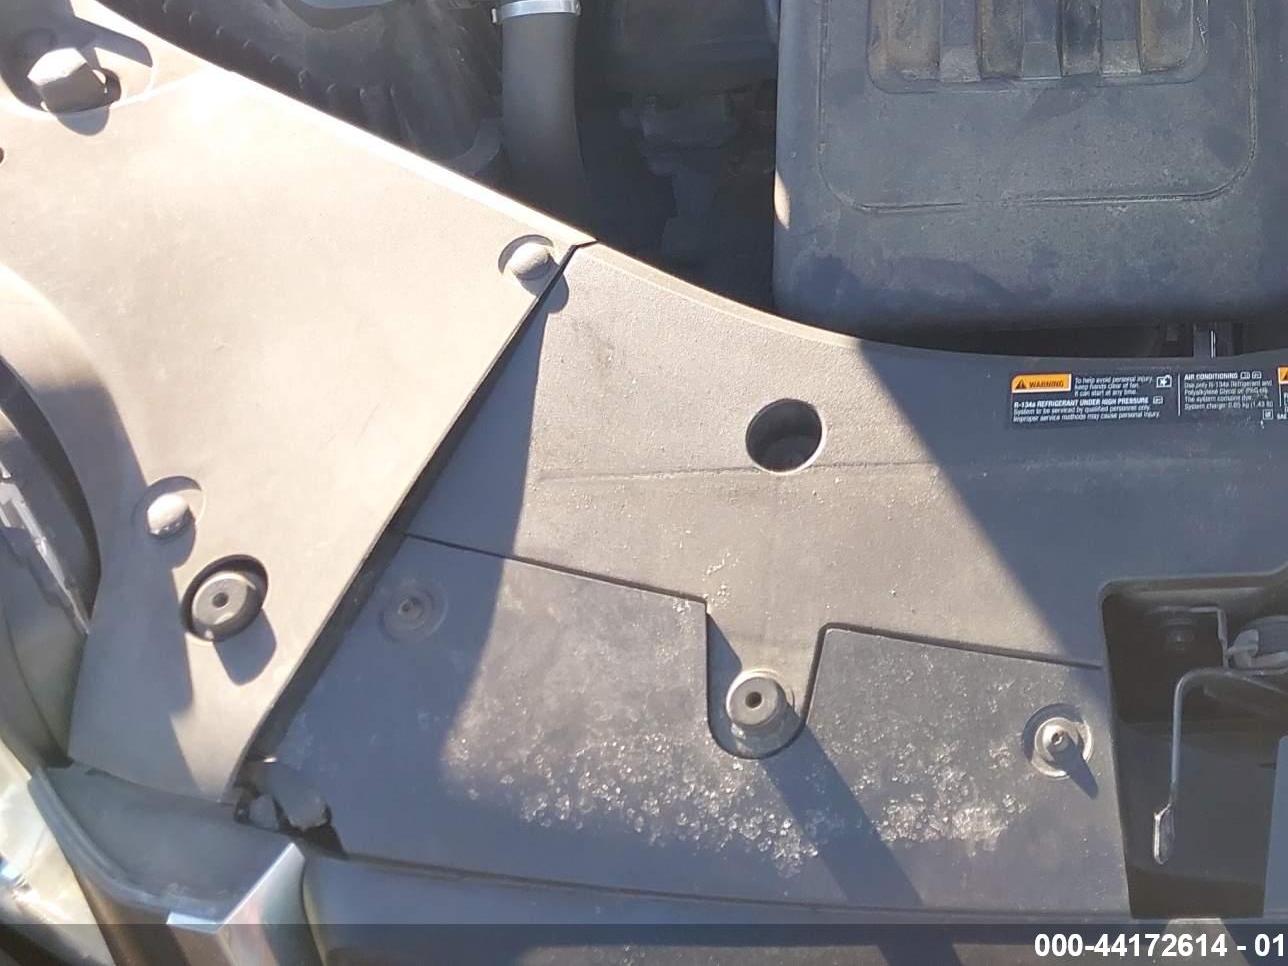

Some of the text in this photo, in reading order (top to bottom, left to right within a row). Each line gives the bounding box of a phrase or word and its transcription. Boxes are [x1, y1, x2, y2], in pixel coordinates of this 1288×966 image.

[1083, 377, 1095, 385] help
[1112, 376, 1137, 384] personal
[1196, 372, 1238, 380] CONDITIONING
[1030, 380, 1064, 389] WARNING
[1075, 384, 1088, 392] keep
[1037, 399, 1079, 408] REFRIGERANT
[1080, 398, 1101, 406] UNDER
[1118, 397, 1149, 405] PRESSURE
[1014, 408, 1035, 416] System
[1085, 405, 1108, 413] qualified
[1110, 405, 1137, 413] personnel
[1013, 415, 1039, 423] Improper
[1119, 411, 1143, 419] personal
